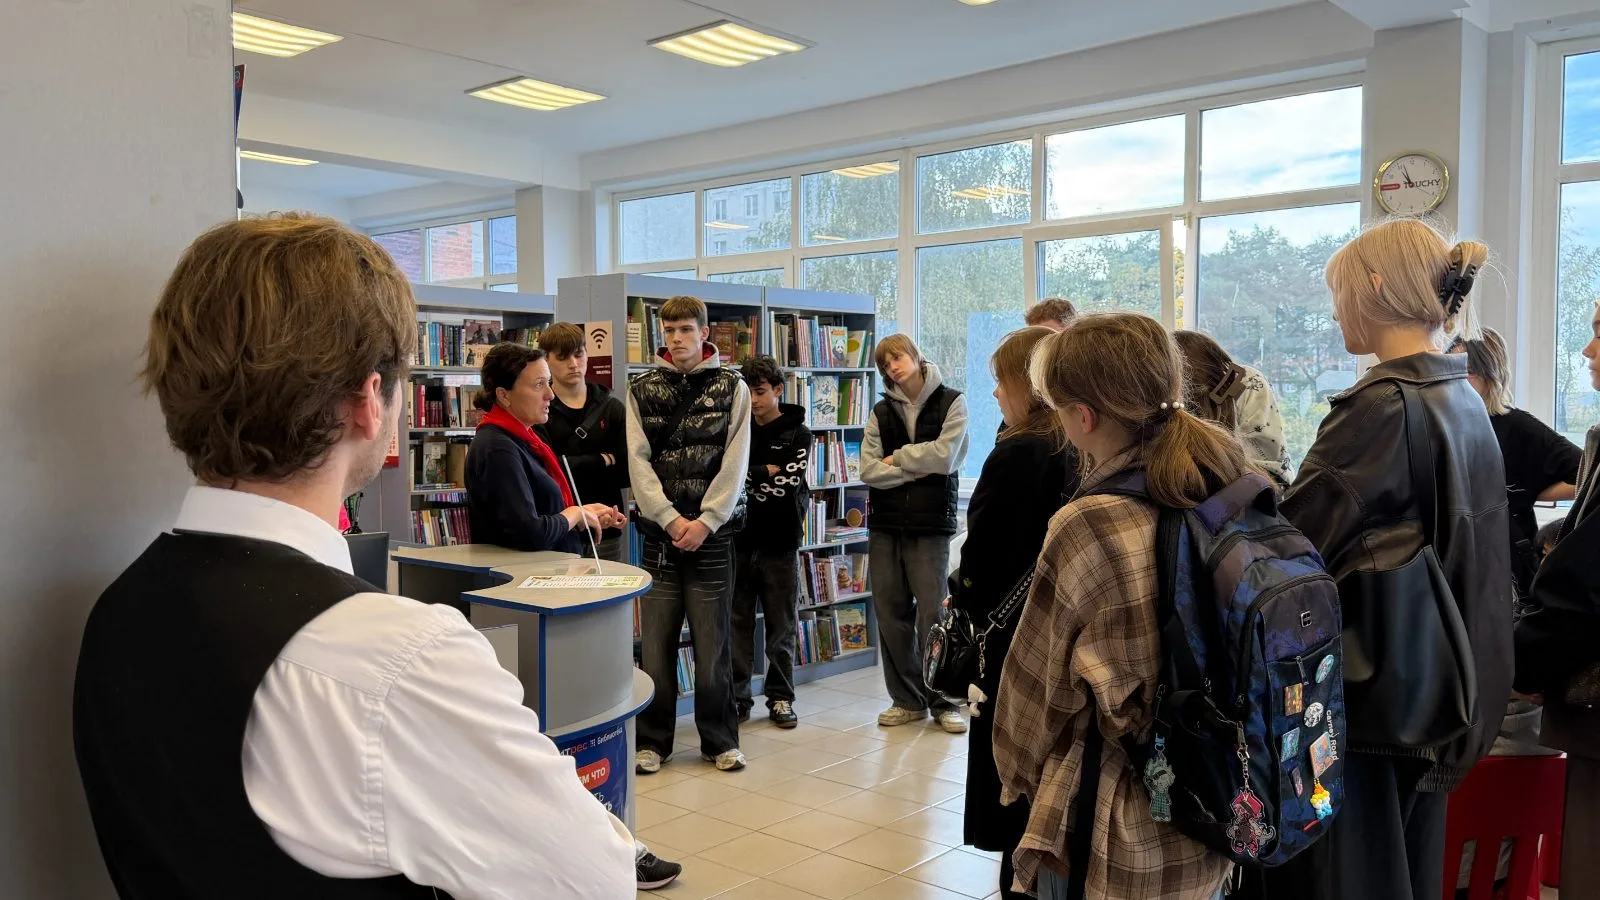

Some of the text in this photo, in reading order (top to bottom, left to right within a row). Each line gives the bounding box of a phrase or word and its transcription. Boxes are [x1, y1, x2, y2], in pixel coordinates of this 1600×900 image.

[1403, 178, 1441, 189] TOUCHY
[597, 726, 623, 745] Библиотека
[591, 767, 606, 780] ЧТО
